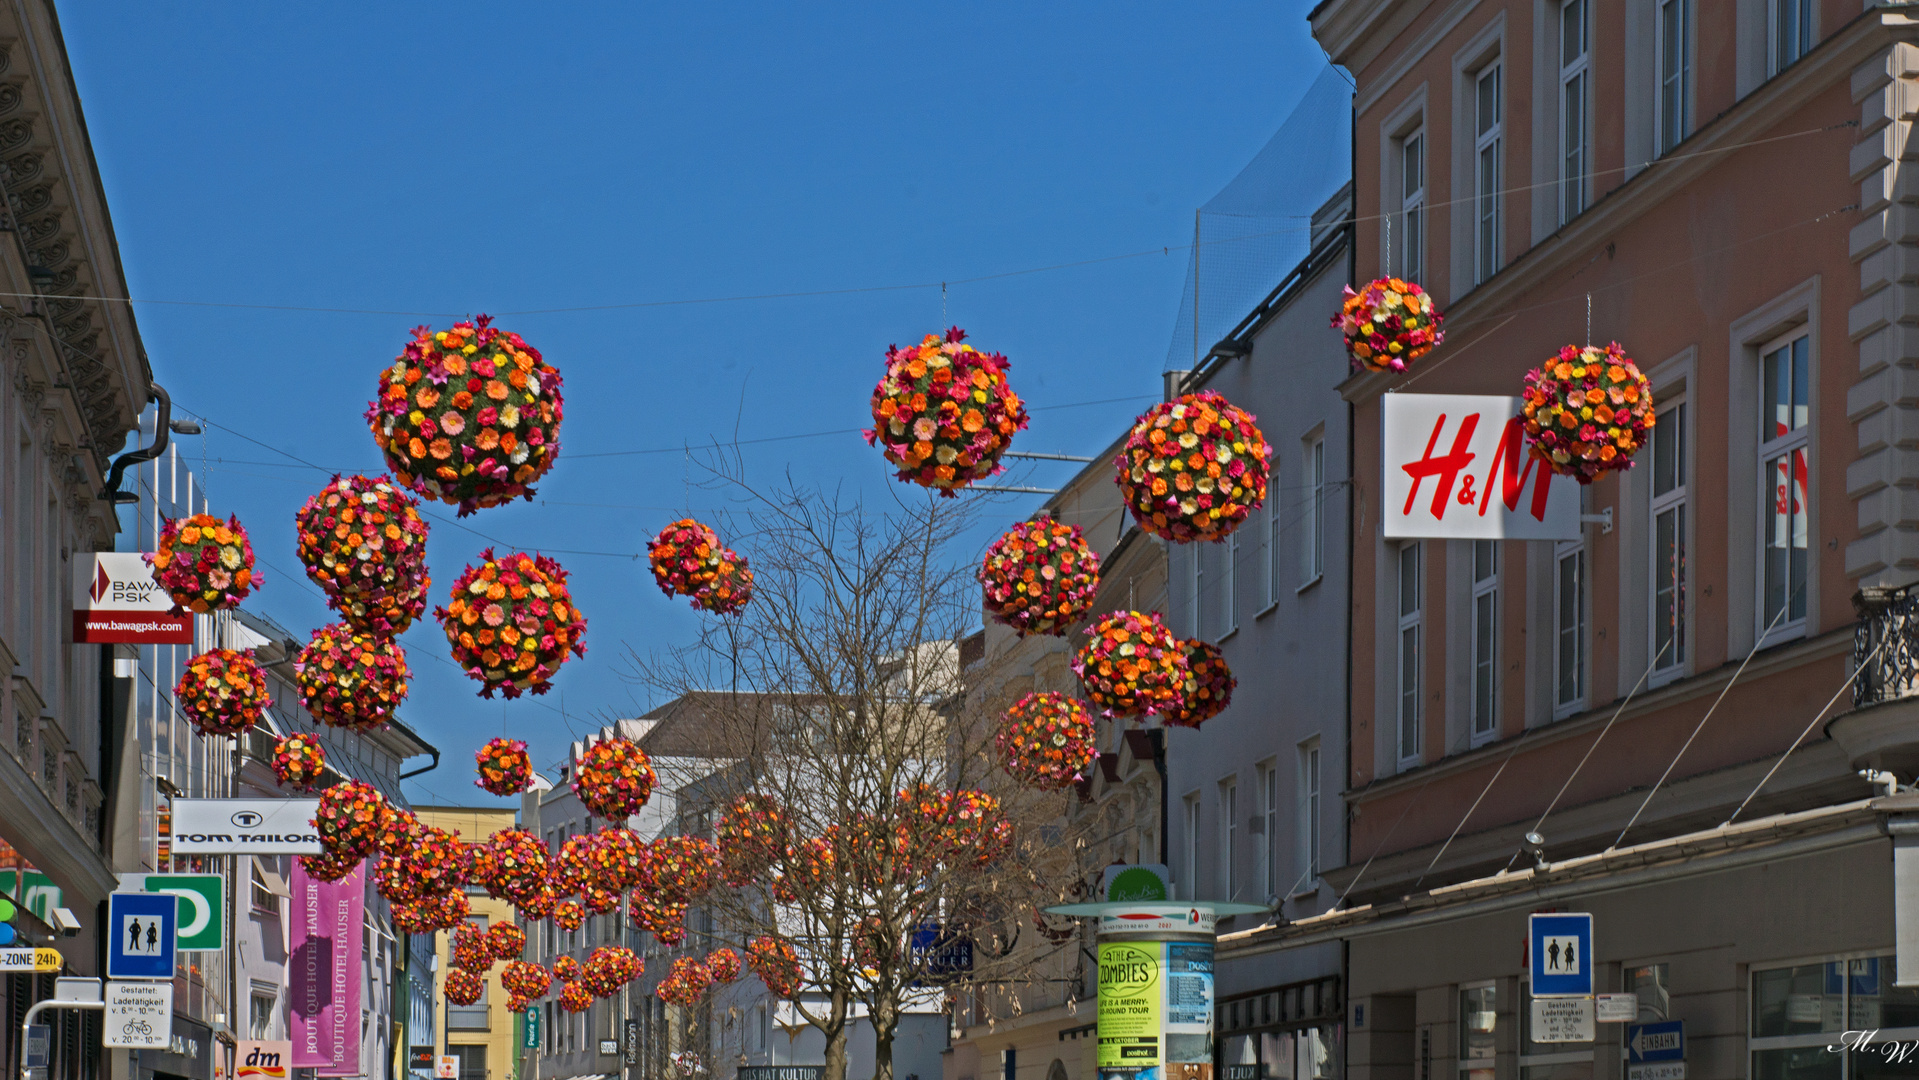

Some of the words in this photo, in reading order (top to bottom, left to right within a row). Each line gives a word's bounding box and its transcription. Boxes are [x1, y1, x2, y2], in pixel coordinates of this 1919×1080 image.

[1401, 412, 1553, 522] H&M
[112, 581, 165, 592] BAWA
[112, 592, 151, 603] PSK
[84, 620, 183, 633] www.bawagpsk.com
[175, 834, 233, 843] TOM
[238, 834, 318, 843] TAILOR
[306, 884, 318, 935] HAUSER
[336, 899, 349, 950] HAUSER
[0, 953, 33, 966] -ZONE
[36, 953, 57, 965] 24h
[306, 938, 318, 983] HOTEL
[1112, 950, 1125, 961] THE
[335, 951, 347, 993] HOTEL
[1100, 962, 1149, 985] ZOMBIES
[121, 986, 158, 994] Gestattet:
[113, 997, 164, 1006] Ladetätigkeit
[1128, 1006, 1149, 1014] TOUR
[306, 985, 319, 1054] BOUTIQUE
[333, 996, 348, 1062] BOUTIQUE
[1641, 1032, 1675, 1050] EINBAHN
[245, 1046, 281, 1067] dm
[760, 1069, 776, 1080] HAT
[780, 1068, 817, 1080] KULTUR
